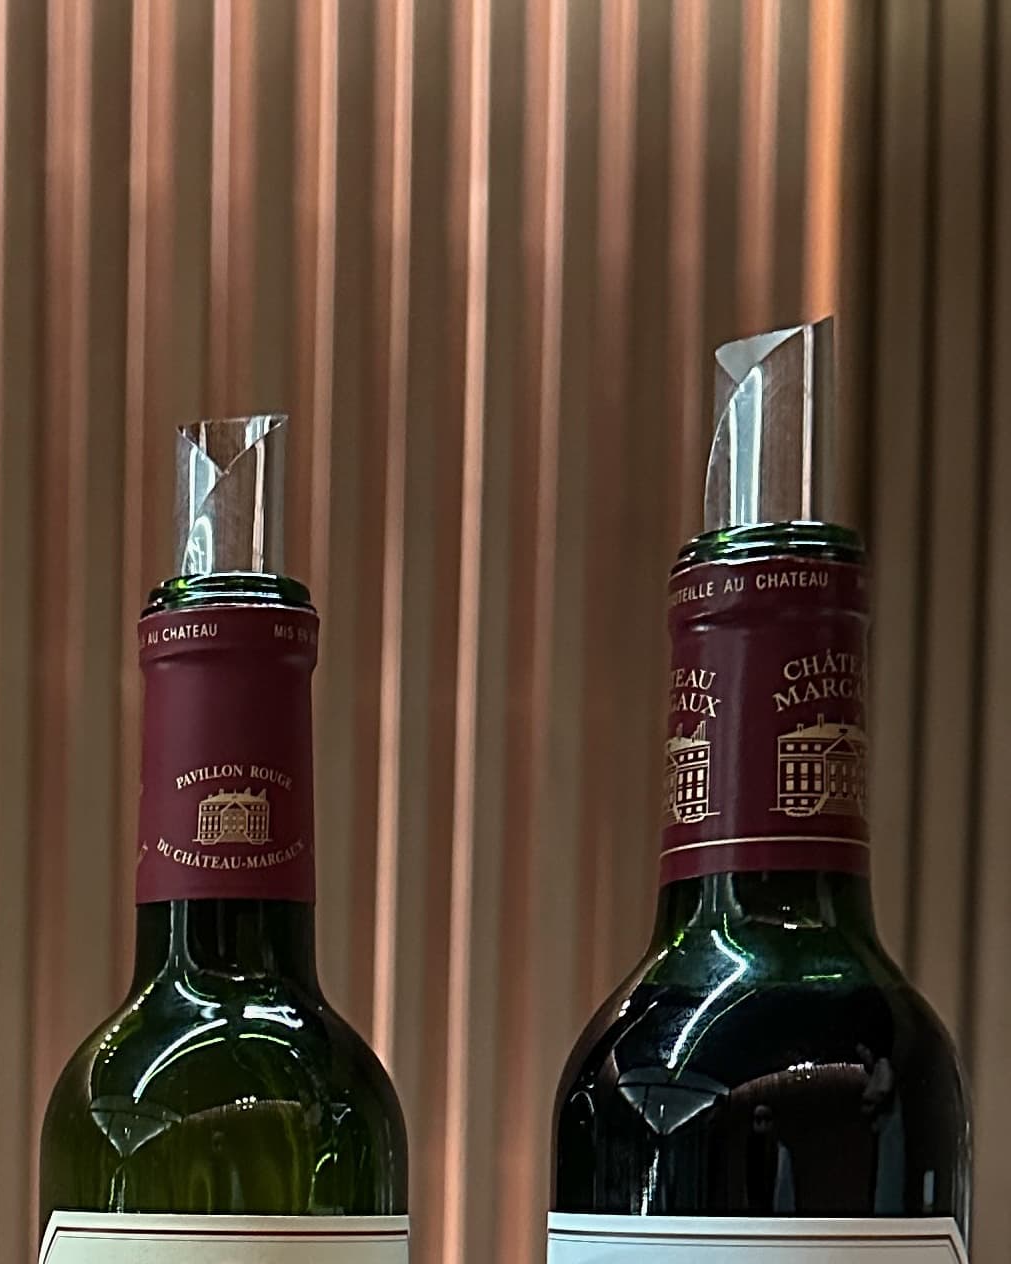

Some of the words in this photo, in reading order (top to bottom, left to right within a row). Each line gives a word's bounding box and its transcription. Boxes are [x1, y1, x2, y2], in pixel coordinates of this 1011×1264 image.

[723, 575, 745, 594] AU
[756, 571, 829, 590] CHATEAU
[147, 629, 159, 647] AU
[162, 623, 218, 643] CHATEAU
[274, 623, 294, 640] MIS
[175, 764, 243, 790] PAVILLON
[249, 765, 293, 792] ROUGE
[156, 837, 174, 858] DU
